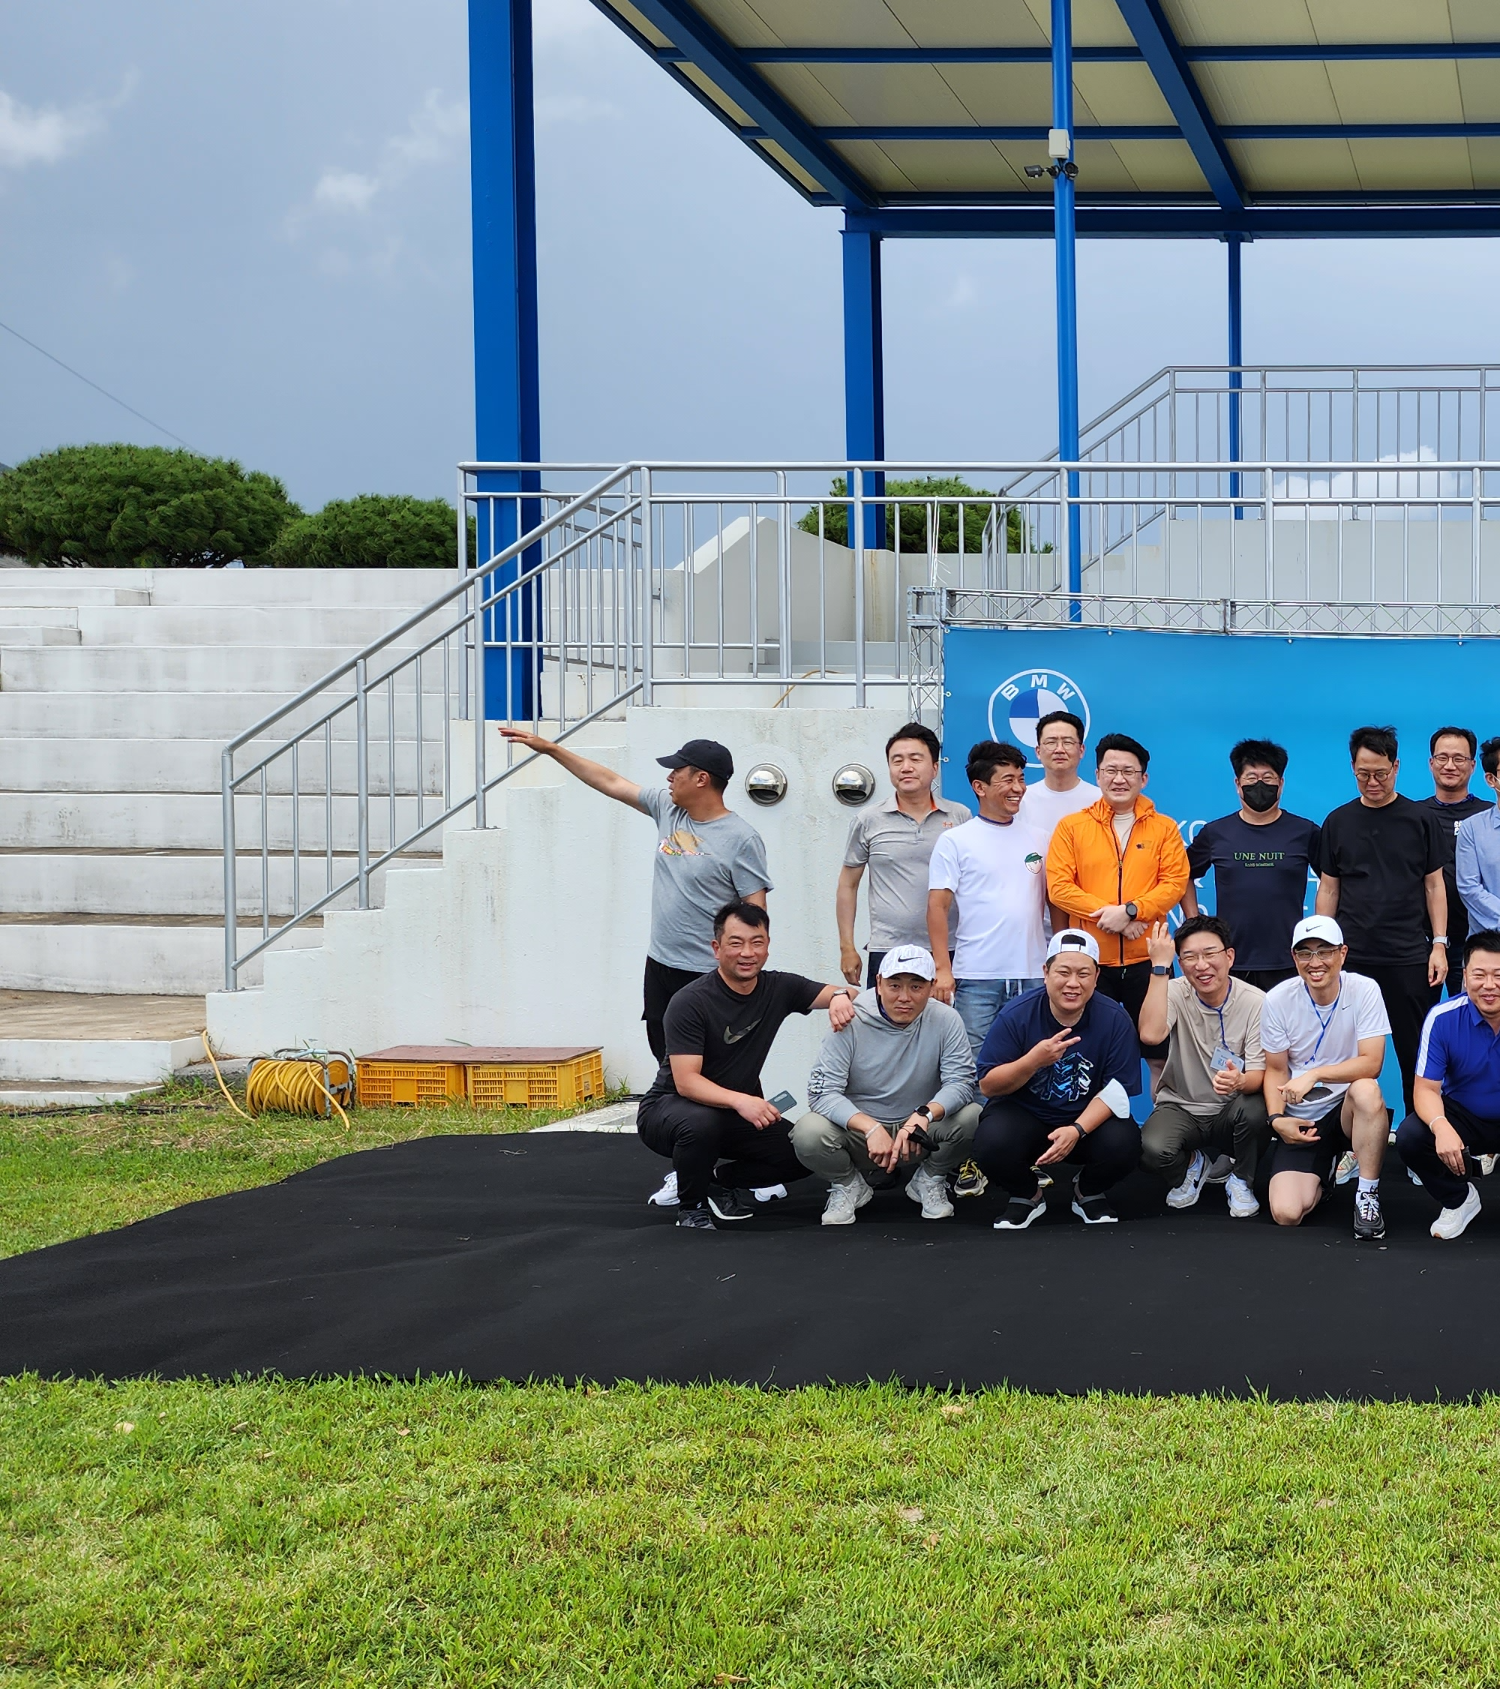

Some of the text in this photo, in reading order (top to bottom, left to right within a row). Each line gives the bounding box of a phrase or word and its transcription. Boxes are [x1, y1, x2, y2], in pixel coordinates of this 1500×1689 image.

[1000, 674, 1076, 701] BMW
[1234, 852, 1285, 861] UNE NUIT
